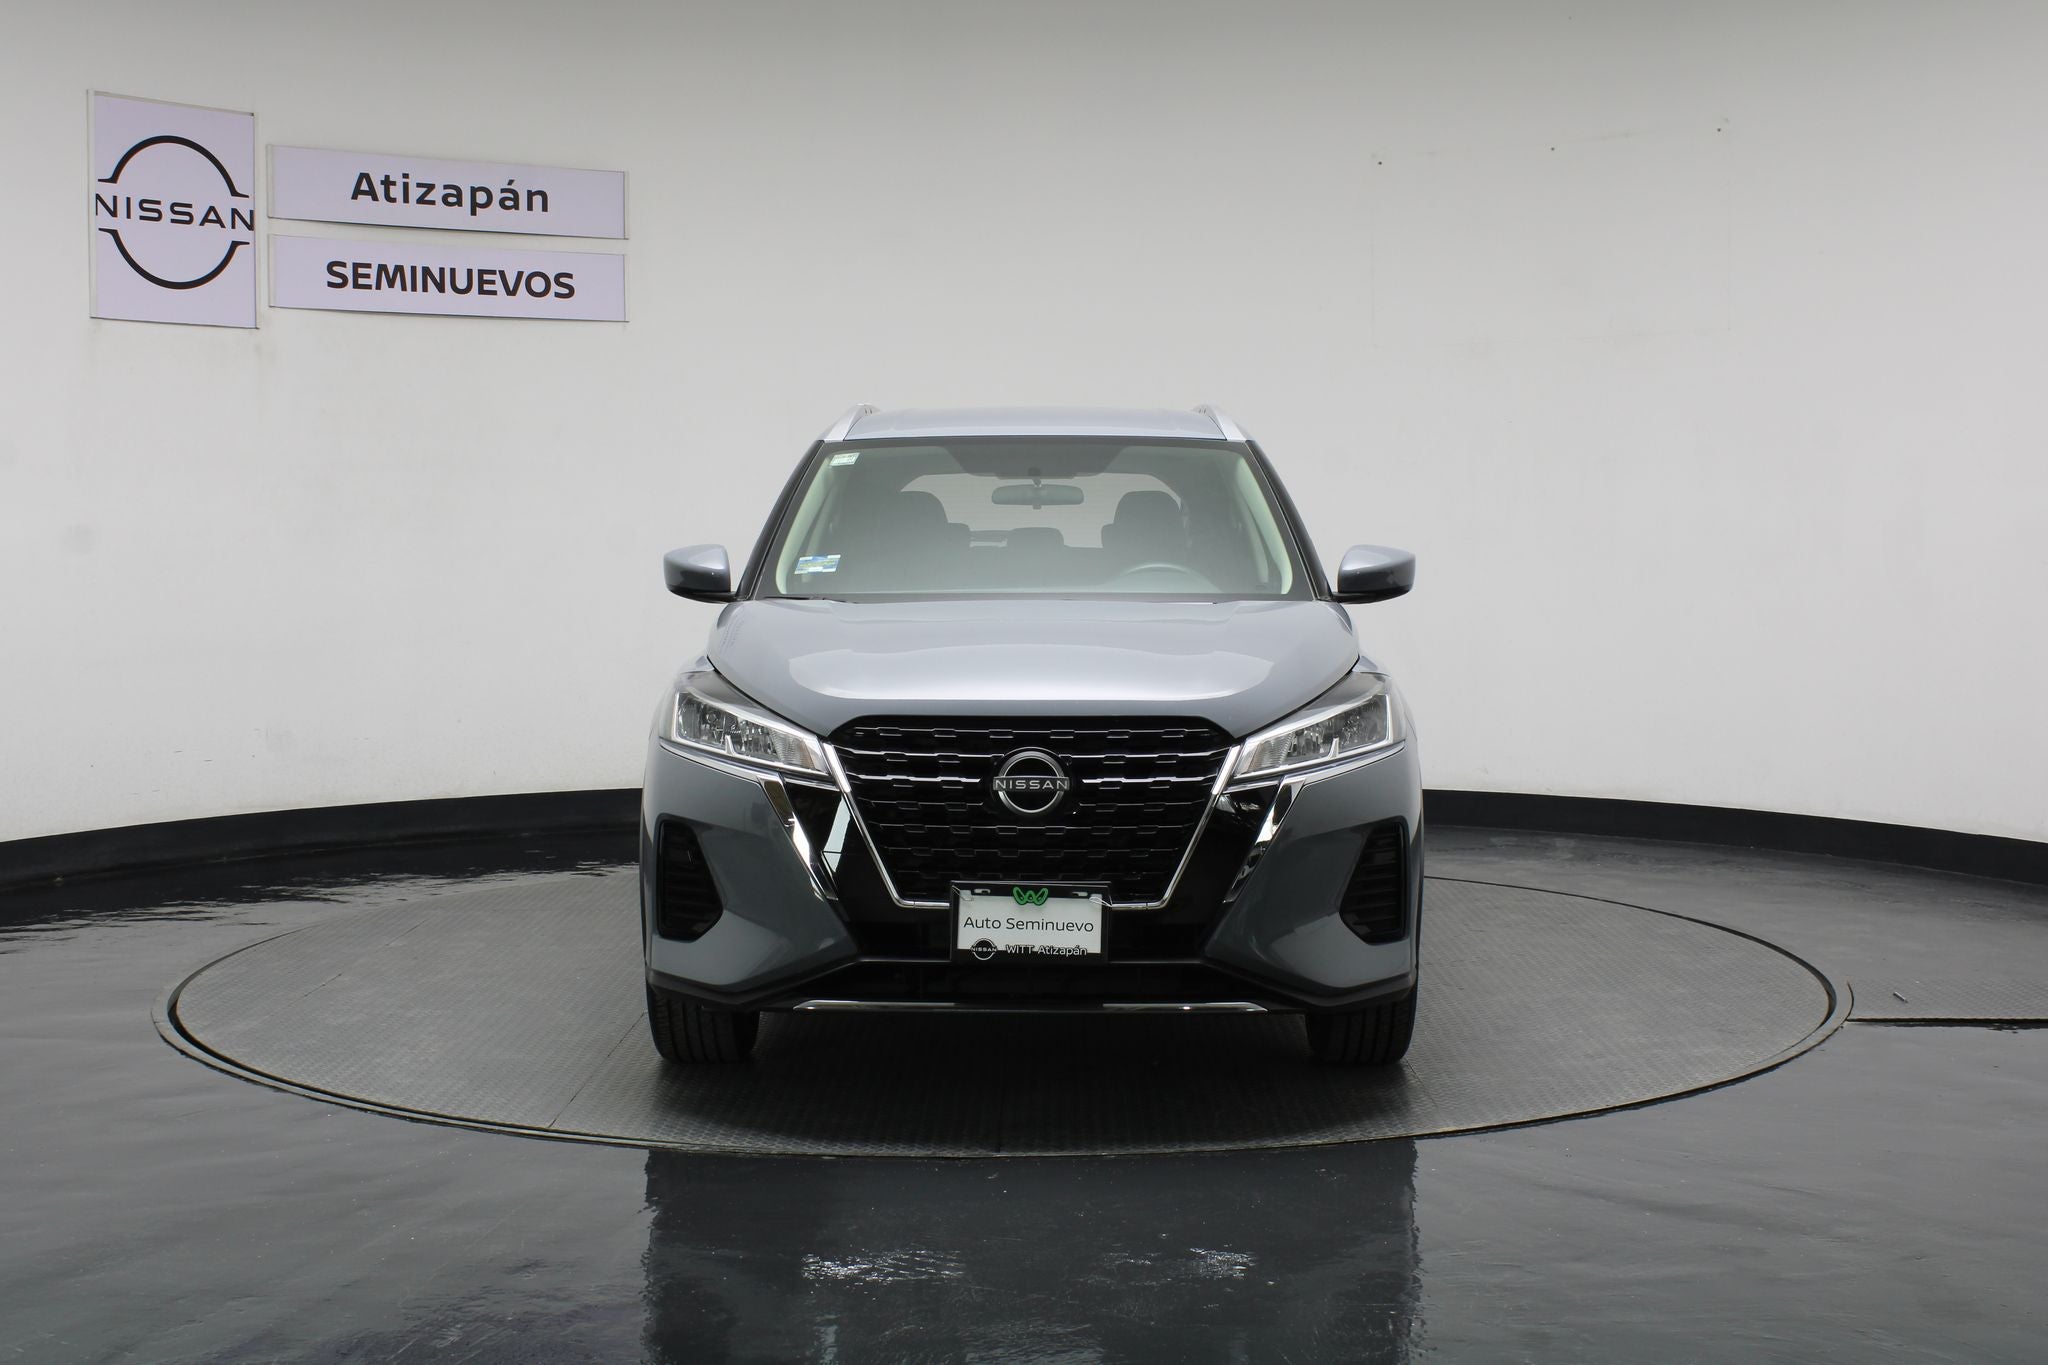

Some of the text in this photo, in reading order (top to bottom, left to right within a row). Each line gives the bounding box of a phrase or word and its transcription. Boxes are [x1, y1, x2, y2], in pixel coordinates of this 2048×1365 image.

[350, 171, 550, 217] Atizapán
[95, 192, 255, 232] NISSAN
[325, 260, 576, 299] SEMINUEVOS
[995, 779, 1068, 790] NISSAN
[963, 916, 1094, 933] Auto Seminuevo
[1005, 944, 1088, 957] WITT Atizapán
